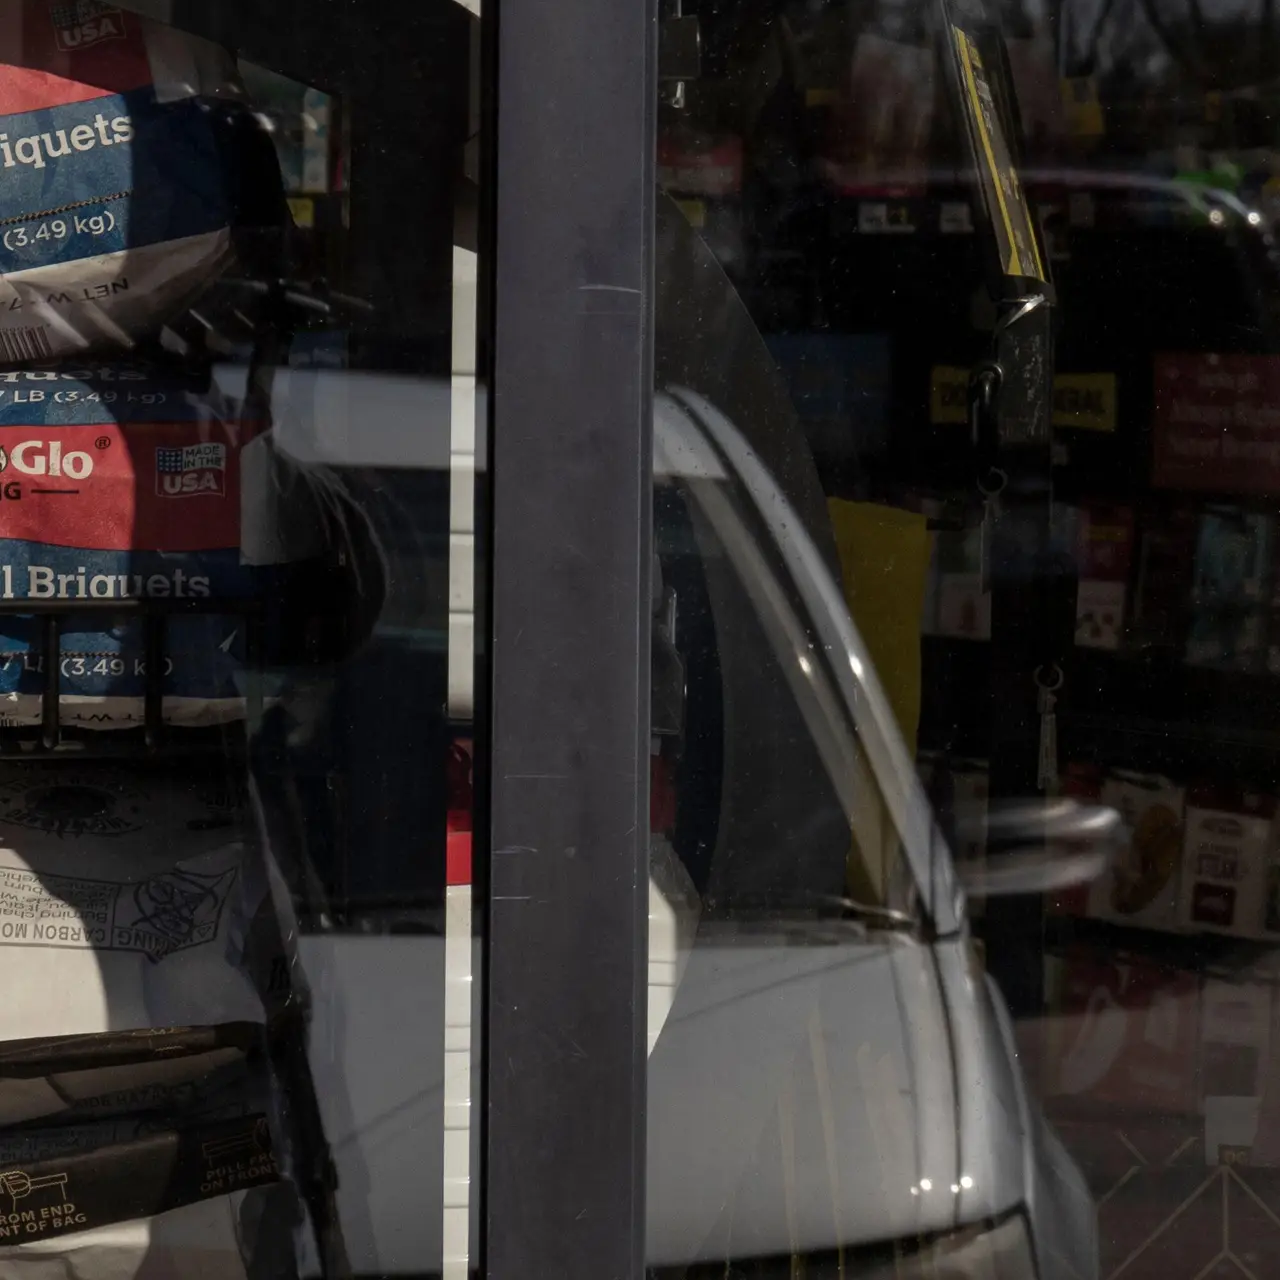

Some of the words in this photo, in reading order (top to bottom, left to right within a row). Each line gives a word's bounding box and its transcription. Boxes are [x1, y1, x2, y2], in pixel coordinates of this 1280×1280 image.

[62, 17, 120, 47] USA
[0, 113, 136, 170] iquets
[3, 219, 67, 251] (3.49
[74, 210, 116, 235] kg)
[14, 390, 45, 403] LB
[54, 390, 118, 404] (3.49
[10, 440, 95, 480] Glo
[184, 444, 221, 459] MADE
[183, 457, 199, 469] IN
[200, 456, 223, 469] THE
[162, 470, 219, 495] USA
[28, 564, 211, 599] Briquets
[61, 657, 126, 678] (3.49
[134, 656, 174, 678] k)
[2, 922, 28, 939] MO
[33, 924, 106, 943] CARBON
[40, 1202, 76, 1219] END
[26, 1220, 47, 1233] OF
[52, 1212, 87, 1228] BAG
